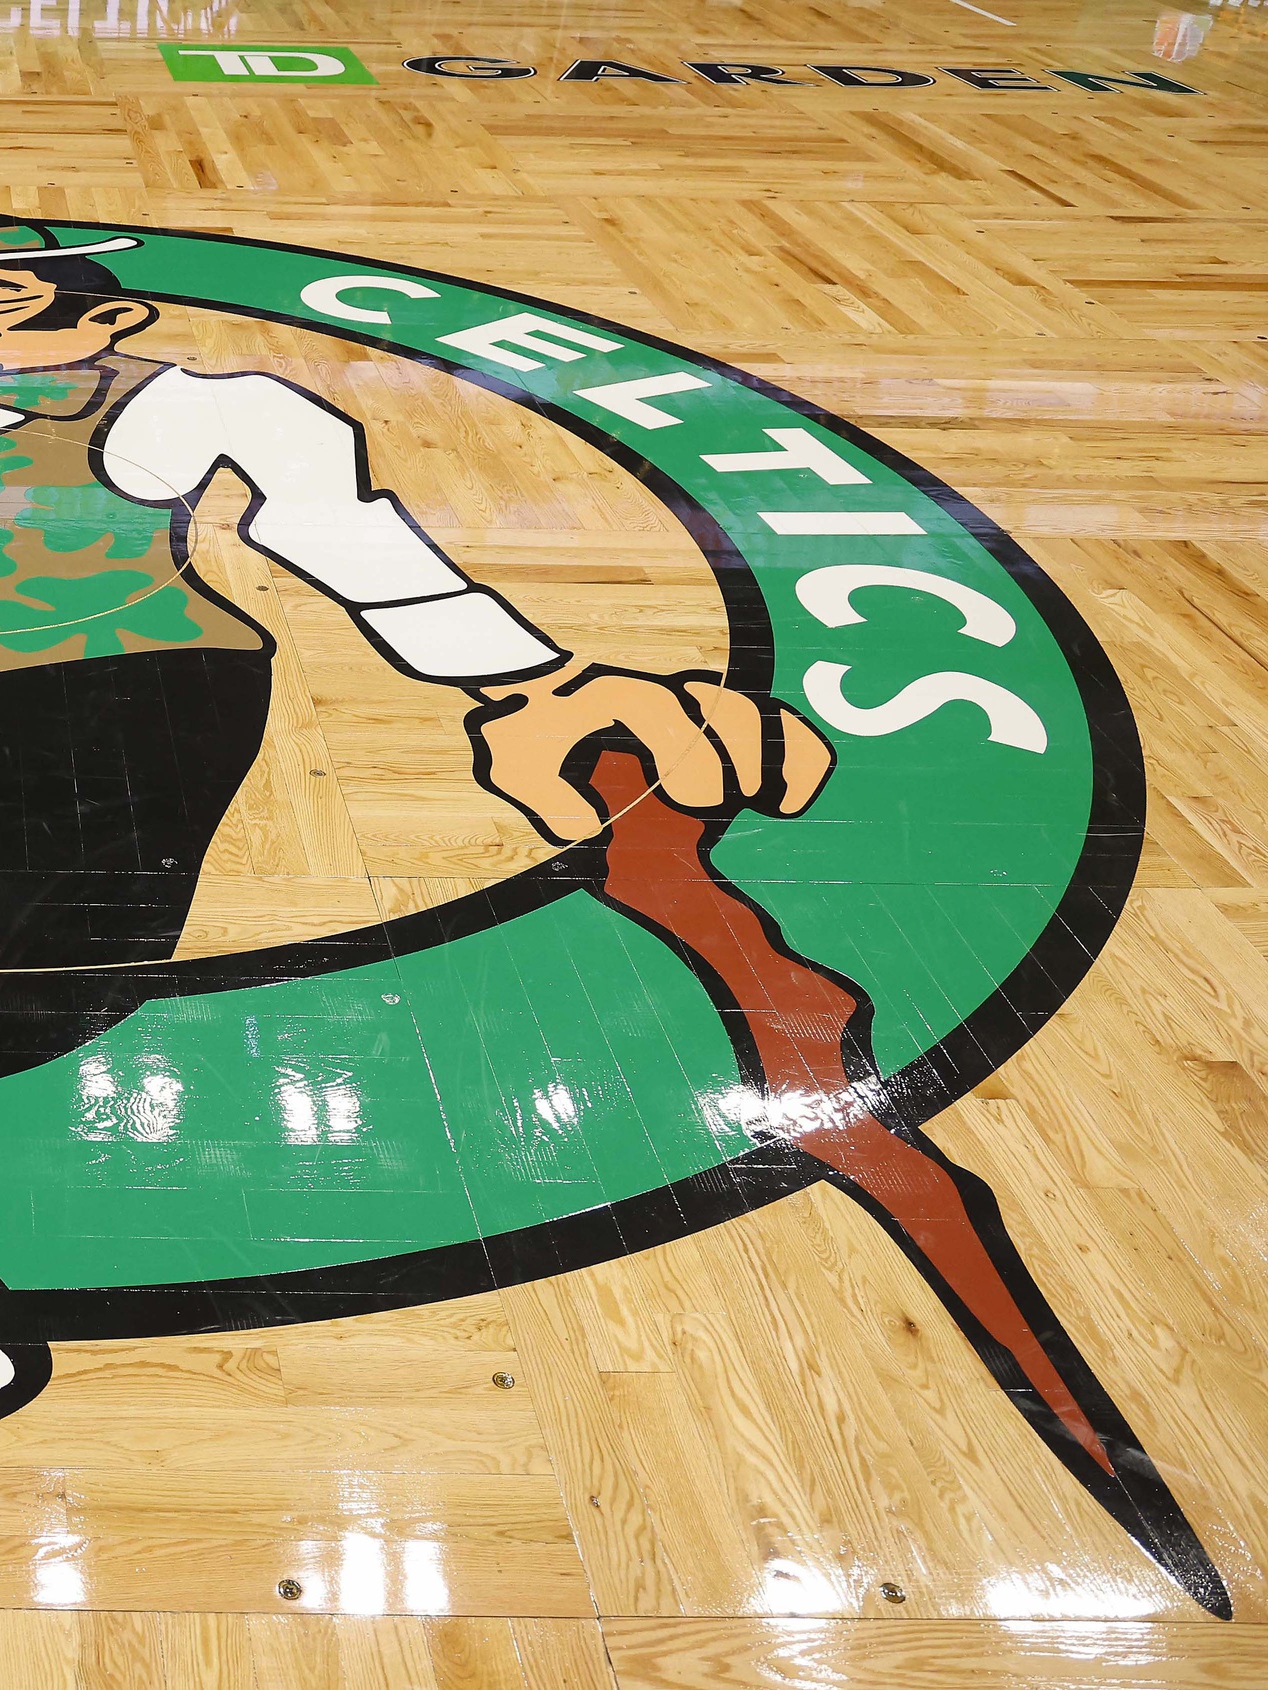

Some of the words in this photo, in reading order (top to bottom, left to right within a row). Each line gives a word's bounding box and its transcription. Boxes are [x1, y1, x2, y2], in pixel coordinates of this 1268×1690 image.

[178, 50, 345, 76] TD
[401, 55, 1207, 95] GARDEN
[300, 275, 1048, 754] CELTICS
